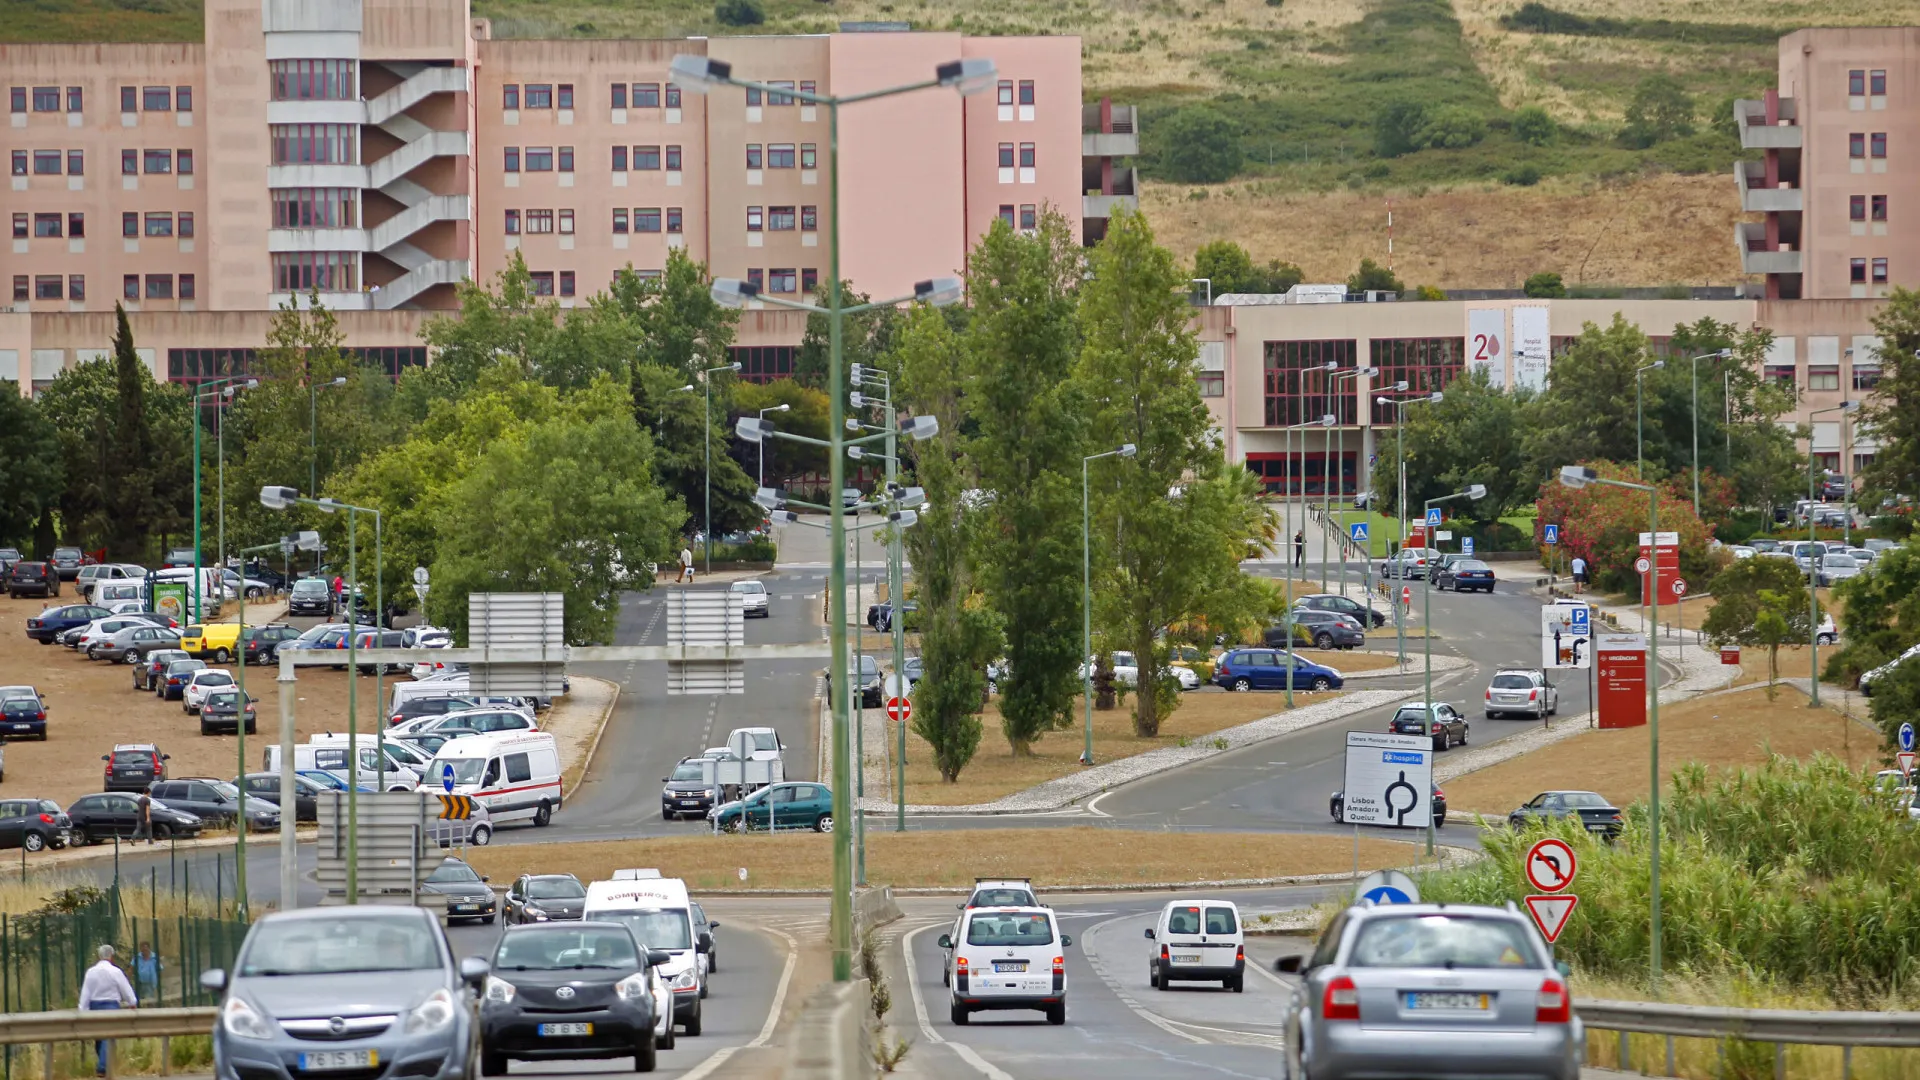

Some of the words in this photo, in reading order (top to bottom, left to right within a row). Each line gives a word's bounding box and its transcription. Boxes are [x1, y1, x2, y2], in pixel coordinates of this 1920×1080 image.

[1393, 753, 1423, 763] hospital
[1351, 796, 1376, 804] Lisboa
[1346, 805, 1380, 813] Amadora
[1350, 813, 1376, 821] Queluz
[607, 892, 669, 901] BOMBEIROS
[308, 1052, 325, 1066] 76
[354, 1050, 368, 1064] 19
